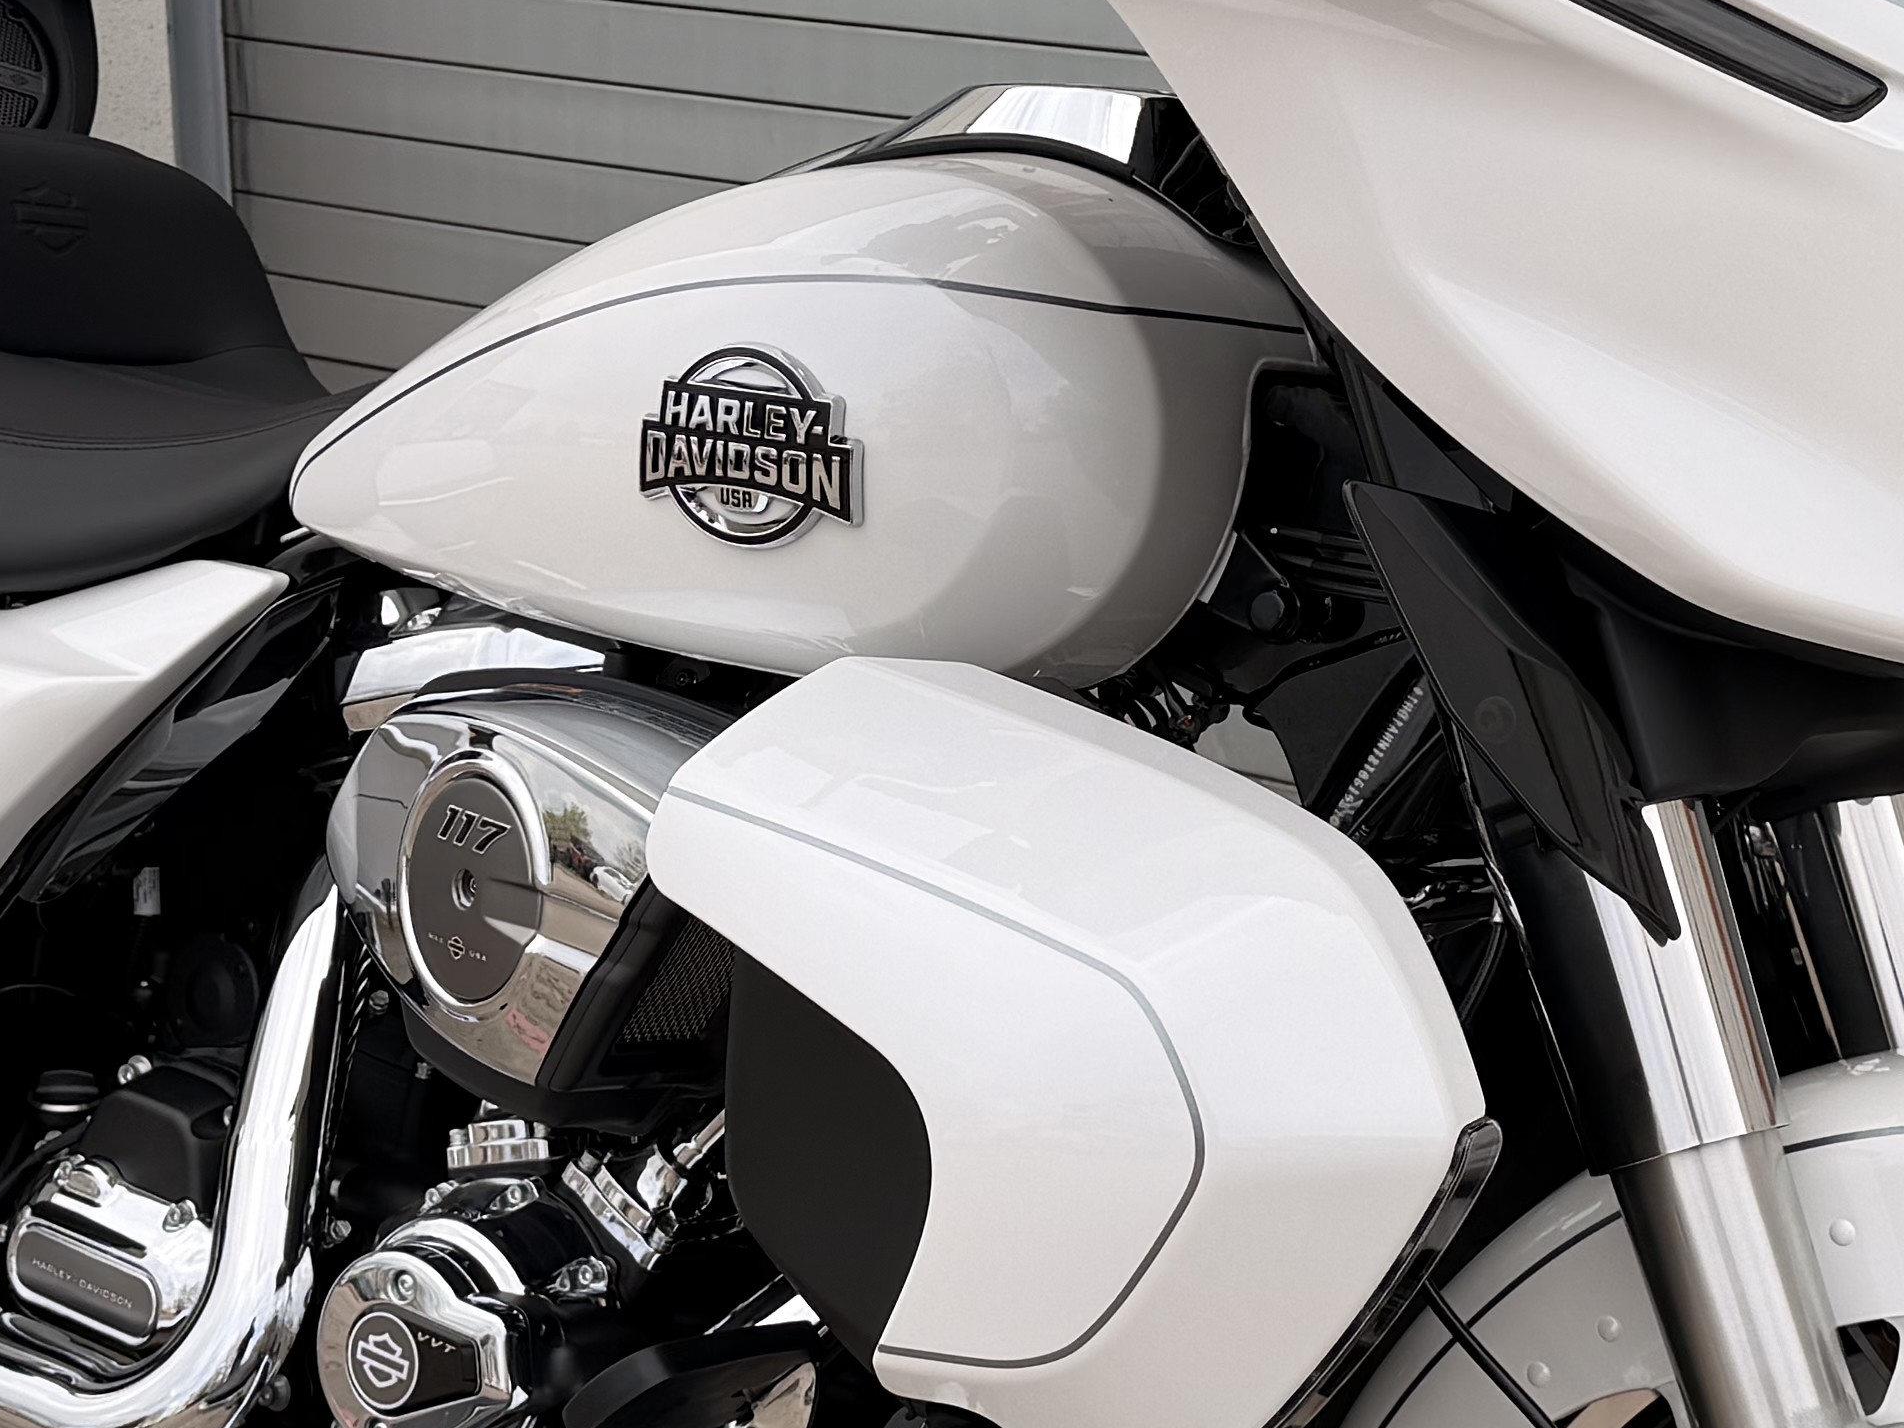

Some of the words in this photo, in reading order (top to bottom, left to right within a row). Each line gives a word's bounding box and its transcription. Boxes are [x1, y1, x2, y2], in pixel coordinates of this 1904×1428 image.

[664, 390, 824, 445] HARLEY-
[645, 429, 841, 510] DAVIDSON
[720, 488, 753, 508] USA
[437, 804, 511, 854] 117
[417, 1331, 456, 1353] VVT
